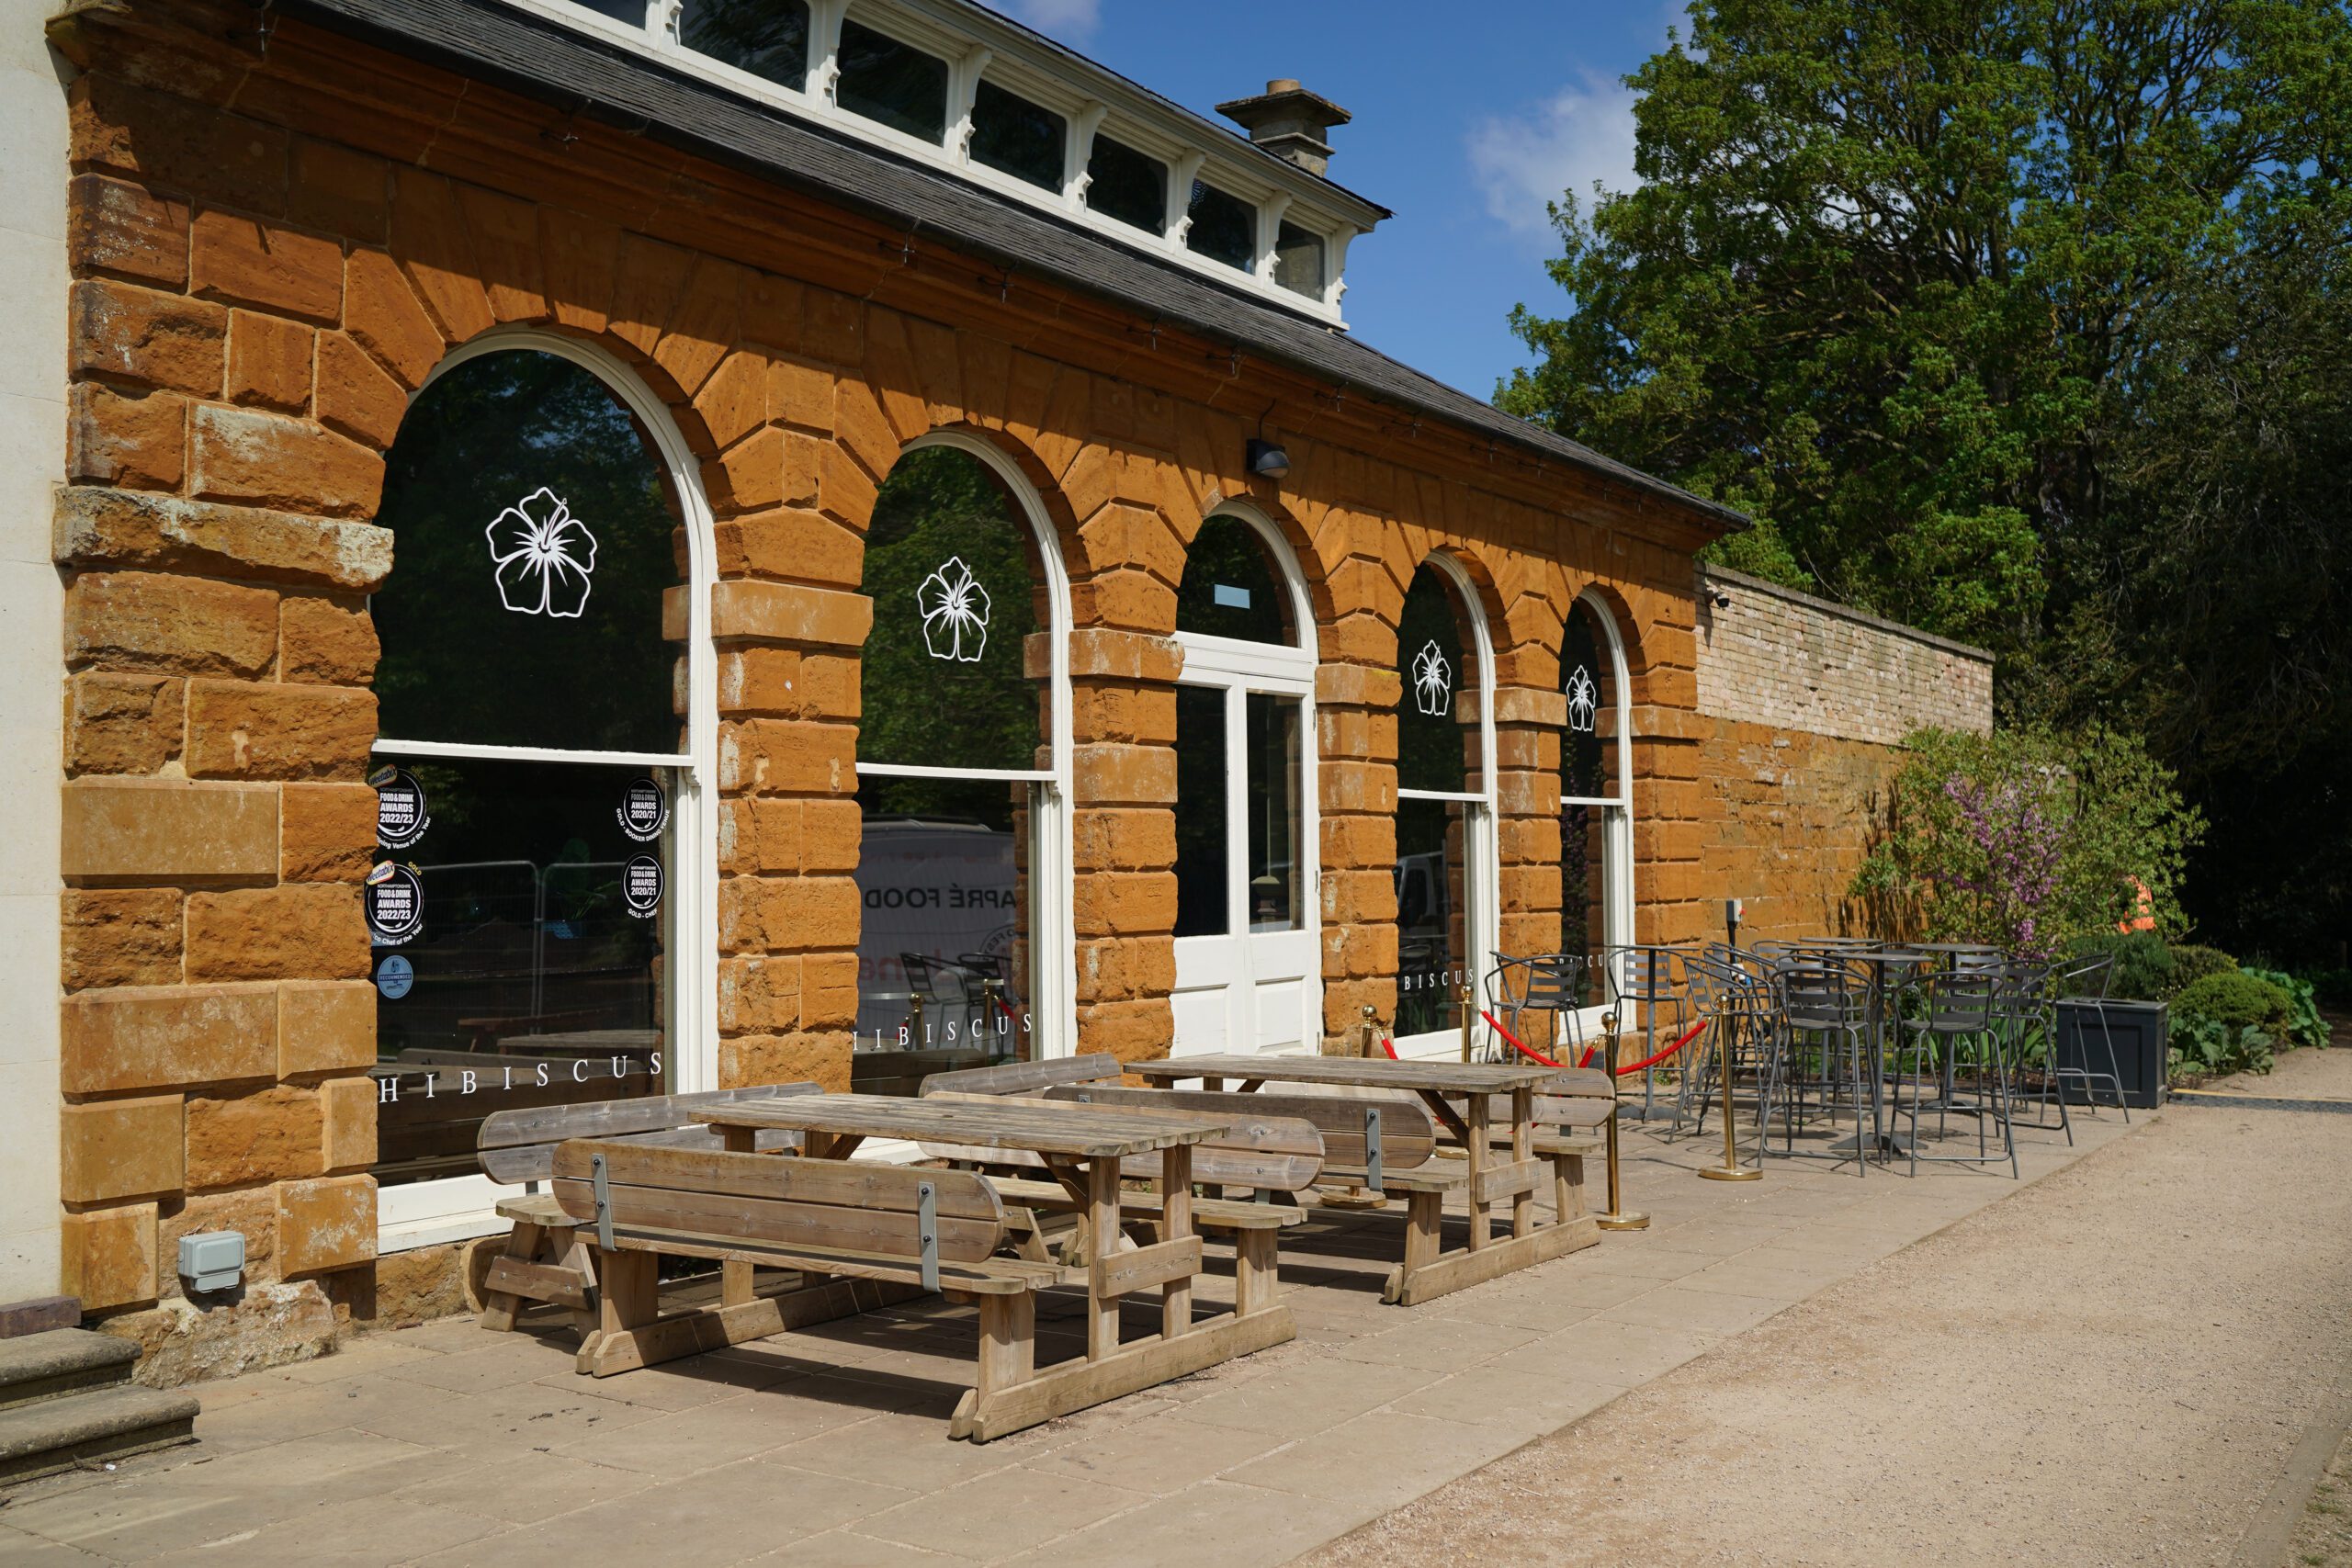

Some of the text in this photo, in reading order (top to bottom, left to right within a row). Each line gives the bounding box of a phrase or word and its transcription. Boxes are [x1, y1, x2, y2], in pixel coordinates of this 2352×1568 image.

[380, 793, 393, 802] FOOD
[398, 794, 414, 803] DRINK
[380, 802, 413, 813] AWARDS
[631, 801, 656, 810] AWARDS
[380, 813, 413, 823] 2022/23
[631, 810, 656, 818] 2020/21
[616, 808, 625, 826] GOLD
[625, 828, 645, 842] BOOKER
[392, 840, 410, 849] Venue
[410, 836, 417, 845] of
[415, 830, 424, 840] the
[423, 816, 431, 830] Year
[408, 861, 422, 876] GOLD
[377, 889, 391, 898] FOOD
[396, 890, 411, 898] DRINK
[631, 887, 656, 895] 2020/21
[377, 899, 411, 908] AWARDS
[377, 909, 411, 920] 2022/23
[628, 908, 642, 918] GOLD
[645, 908, 657, 918] CHEF
[382, 937, 396, 946] Chef
[412, 923, 423, 936] Year
[379, 1052, 662, 1103] HIBISCUS
